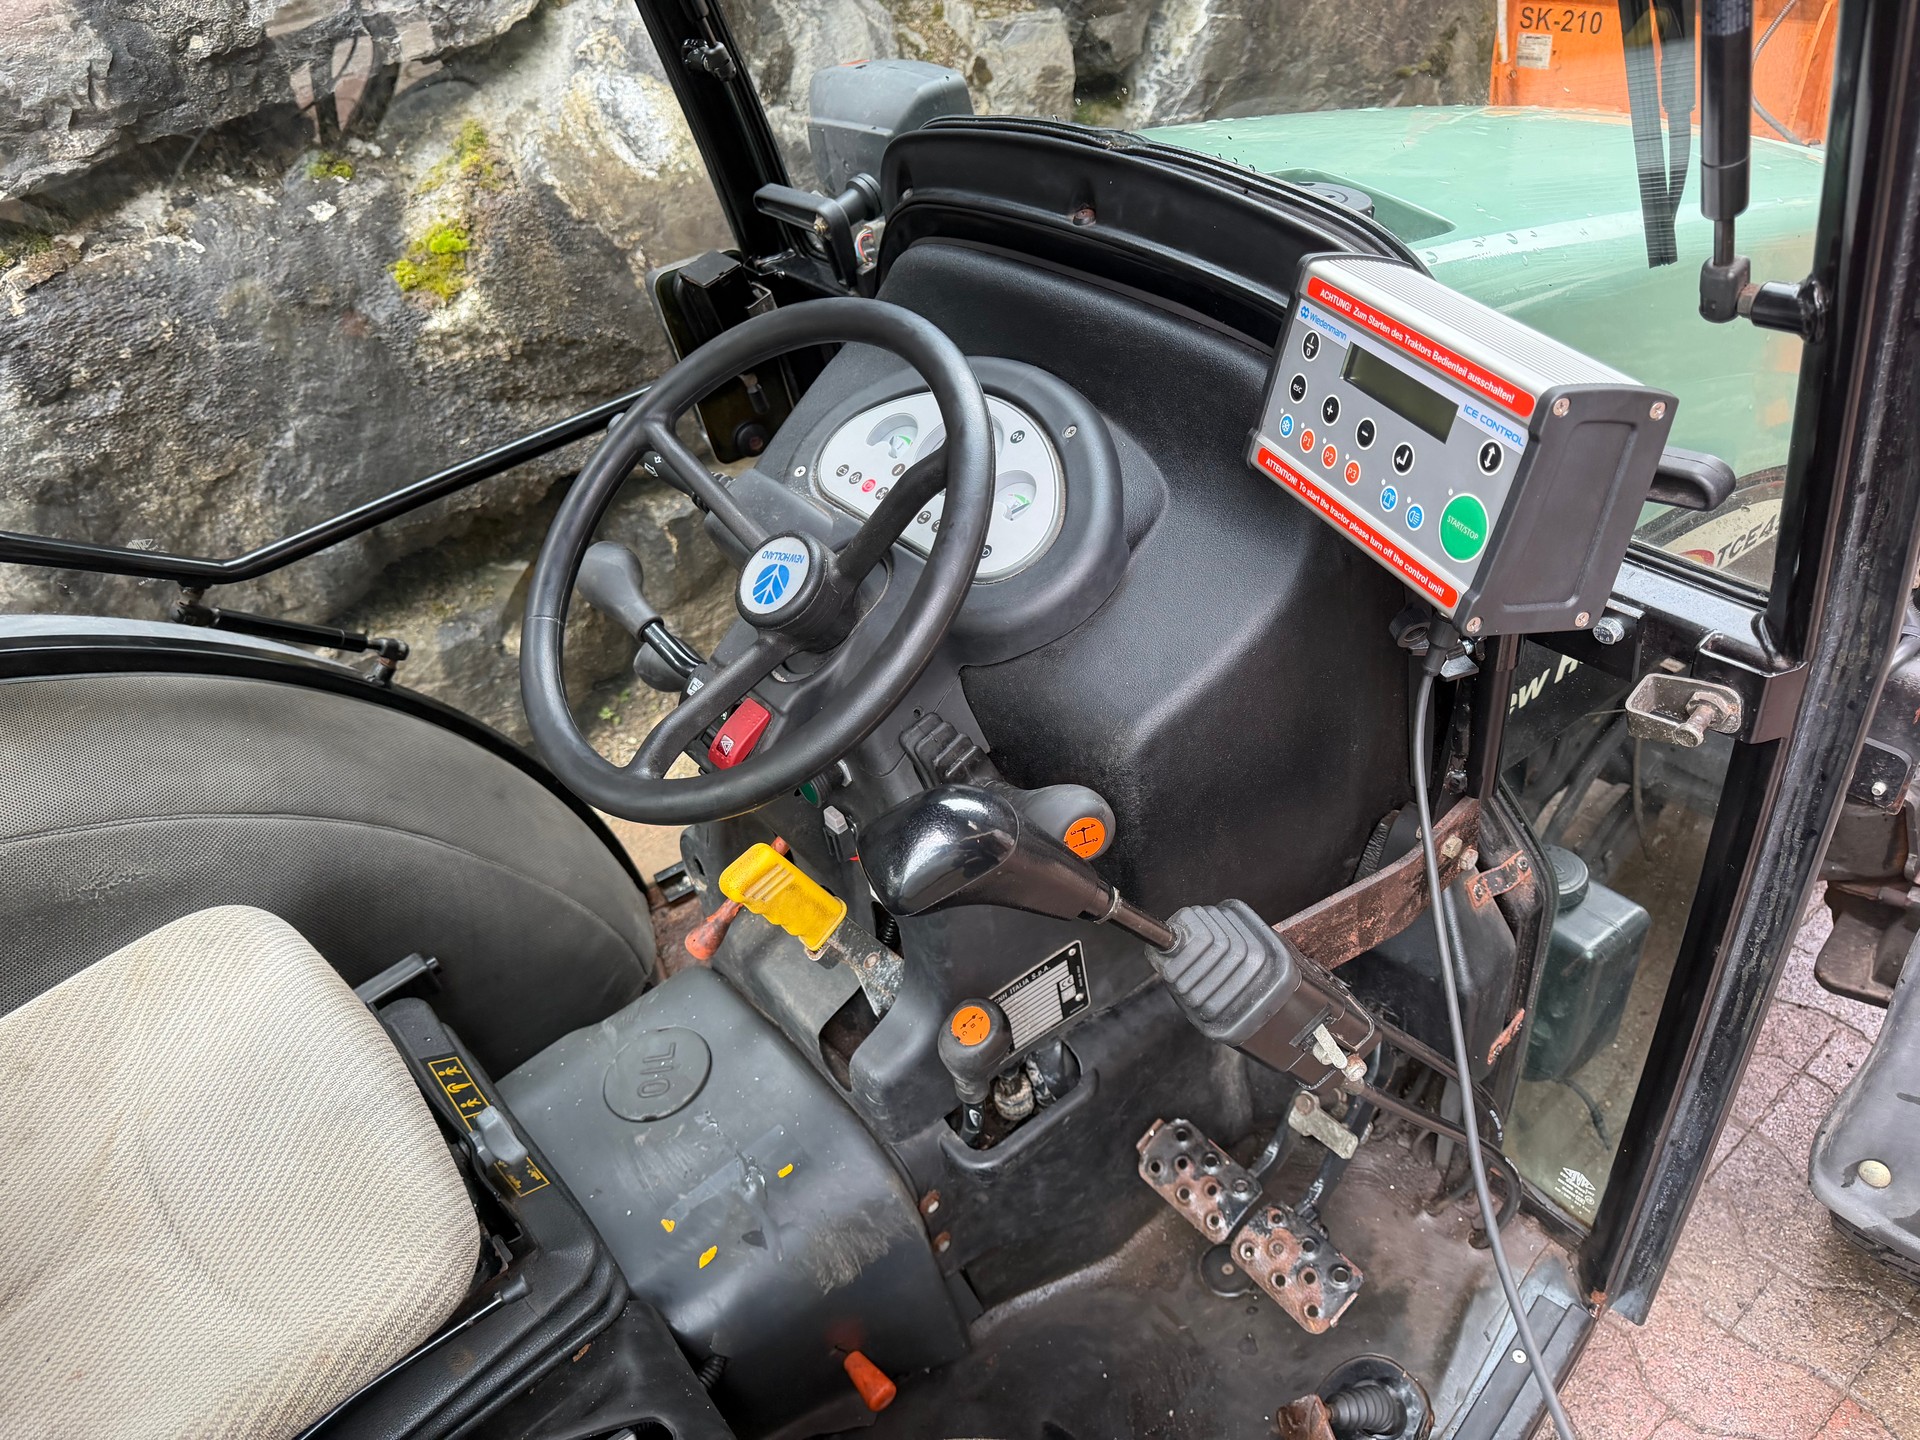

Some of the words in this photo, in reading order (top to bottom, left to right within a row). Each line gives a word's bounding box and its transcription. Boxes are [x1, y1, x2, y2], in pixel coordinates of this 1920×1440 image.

[1520, 6, 1603, 35] SK-210
[1309, 312, 1347, 341] Wiedenmann
[1320, 289, 1352, 312] ACHTUNG!
[1353, 306, 1367, 321] Zum
[1368, 314, 1391, 335] Starten
[1391, 328, 1403, 341] des
[1404, 334, 1432, 357] Traktors
[1432, 350, 1468, 378] Bedienteil
[1467, 370, 1516, 404] ausschalten!
[1463, 404, 1480, 419] ICE
[1480, 414, 1524, 447] CONTROL
[1303, 435, 1311, 447] P1
[1324, 451, 1334, 463] P2
[1347, 467, 1357, 479] P3
[1265, 457, 1298, 486] ATTENTION!
[1299, 481, 1307, 493] To
[1306, 488, 1320, 504] start
[1320, 498, 1330, 511] the
[1330, 505, 1350, 525] tractor
[1349, 521, 1370, 541] please
[1369, 536, 1383, 551] turn
[1383, 546, 1394, 559] off
[1393, 553, 1404, 567] the
[1403, 563, 1429, 586] control
[1428, 580, 1445, 597] unit!
[1446, 514, 1479, 541] START/STOP
[1717, 513, 1780, 568] TCE4
[637, 1042, 677, 1098] OIL
